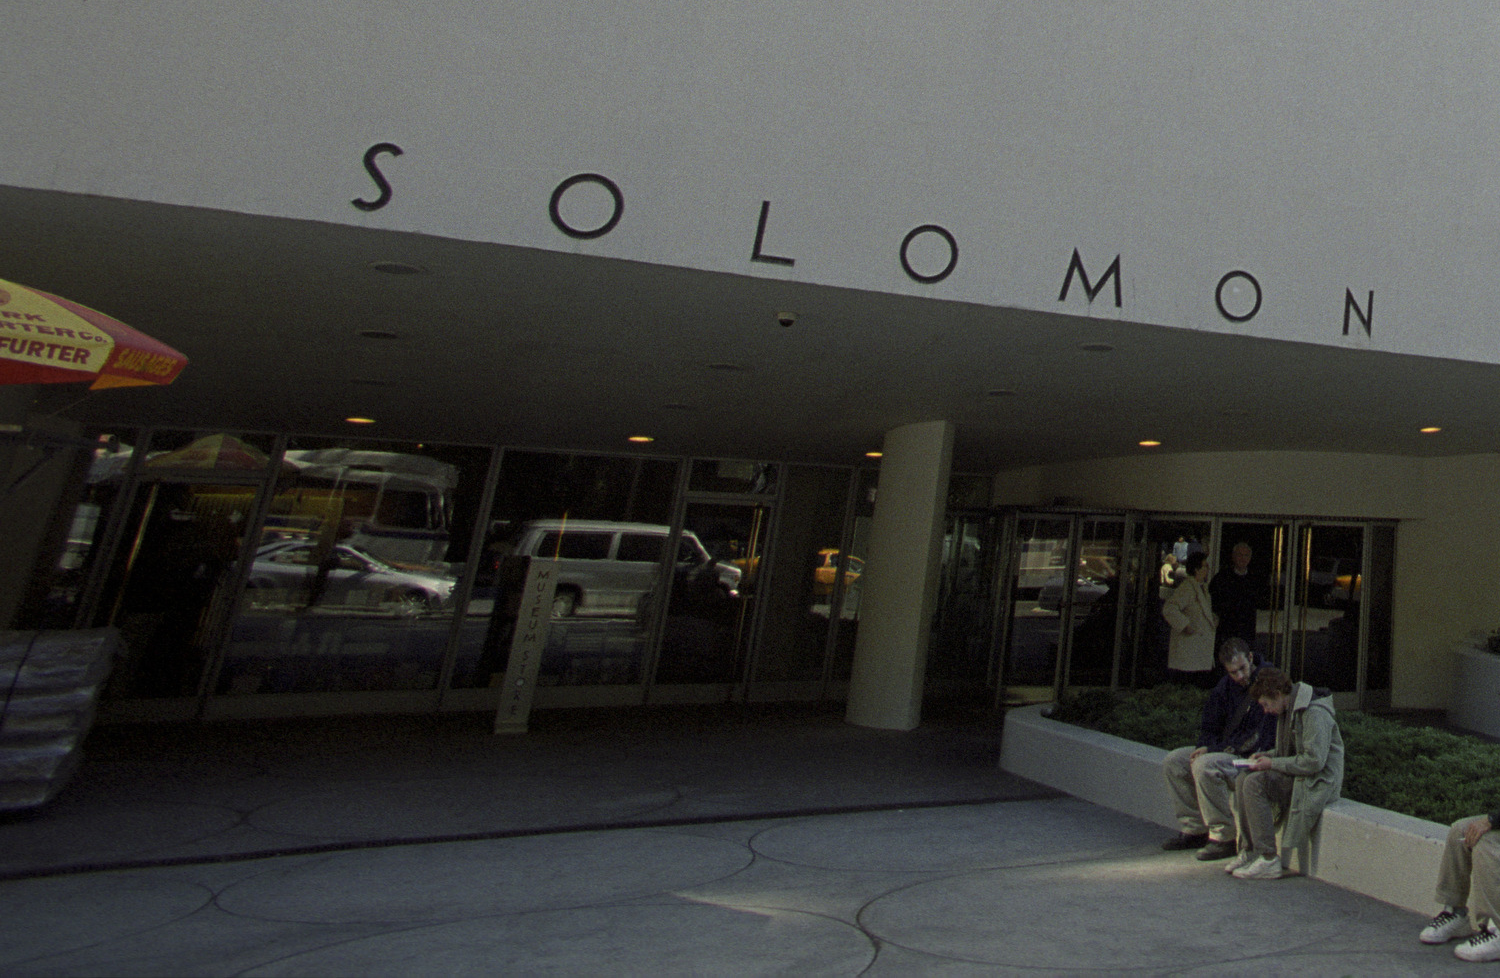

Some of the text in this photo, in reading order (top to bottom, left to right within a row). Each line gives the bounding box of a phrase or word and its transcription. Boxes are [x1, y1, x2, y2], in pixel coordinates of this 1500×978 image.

[350, 142, 1375, 338] SOLOMON
[113, 347, 179, 377] SAUSAGES
[511, 570, 550, 716] MUSEUM STORE
